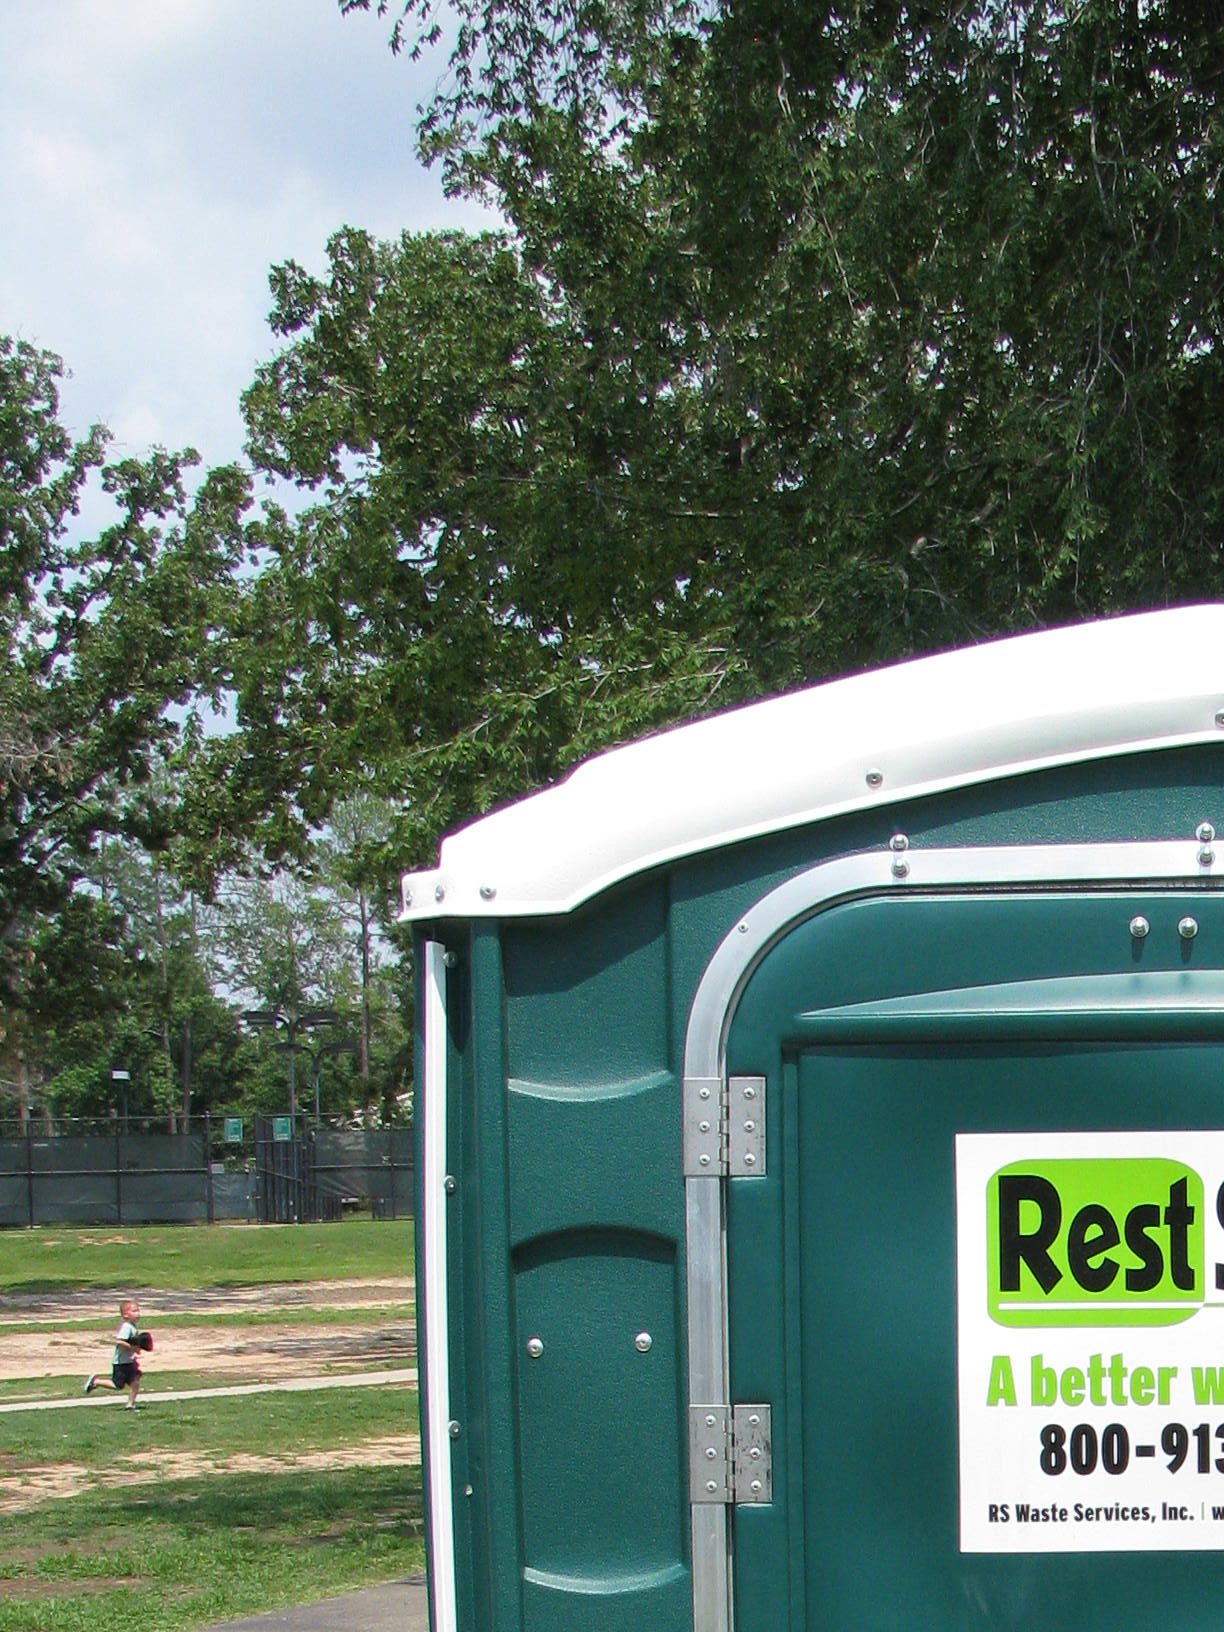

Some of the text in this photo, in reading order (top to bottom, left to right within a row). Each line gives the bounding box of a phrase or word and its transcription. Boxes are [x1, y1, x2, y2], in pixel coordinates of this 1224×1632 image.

[999, 1175, 1195, 1294] Rest
[987, 1356, 1017, 1406] A
[1031, 1354, 1178, 1407] better
[988, 1501, 1195, 1524] RS Waste Services, Inc.
